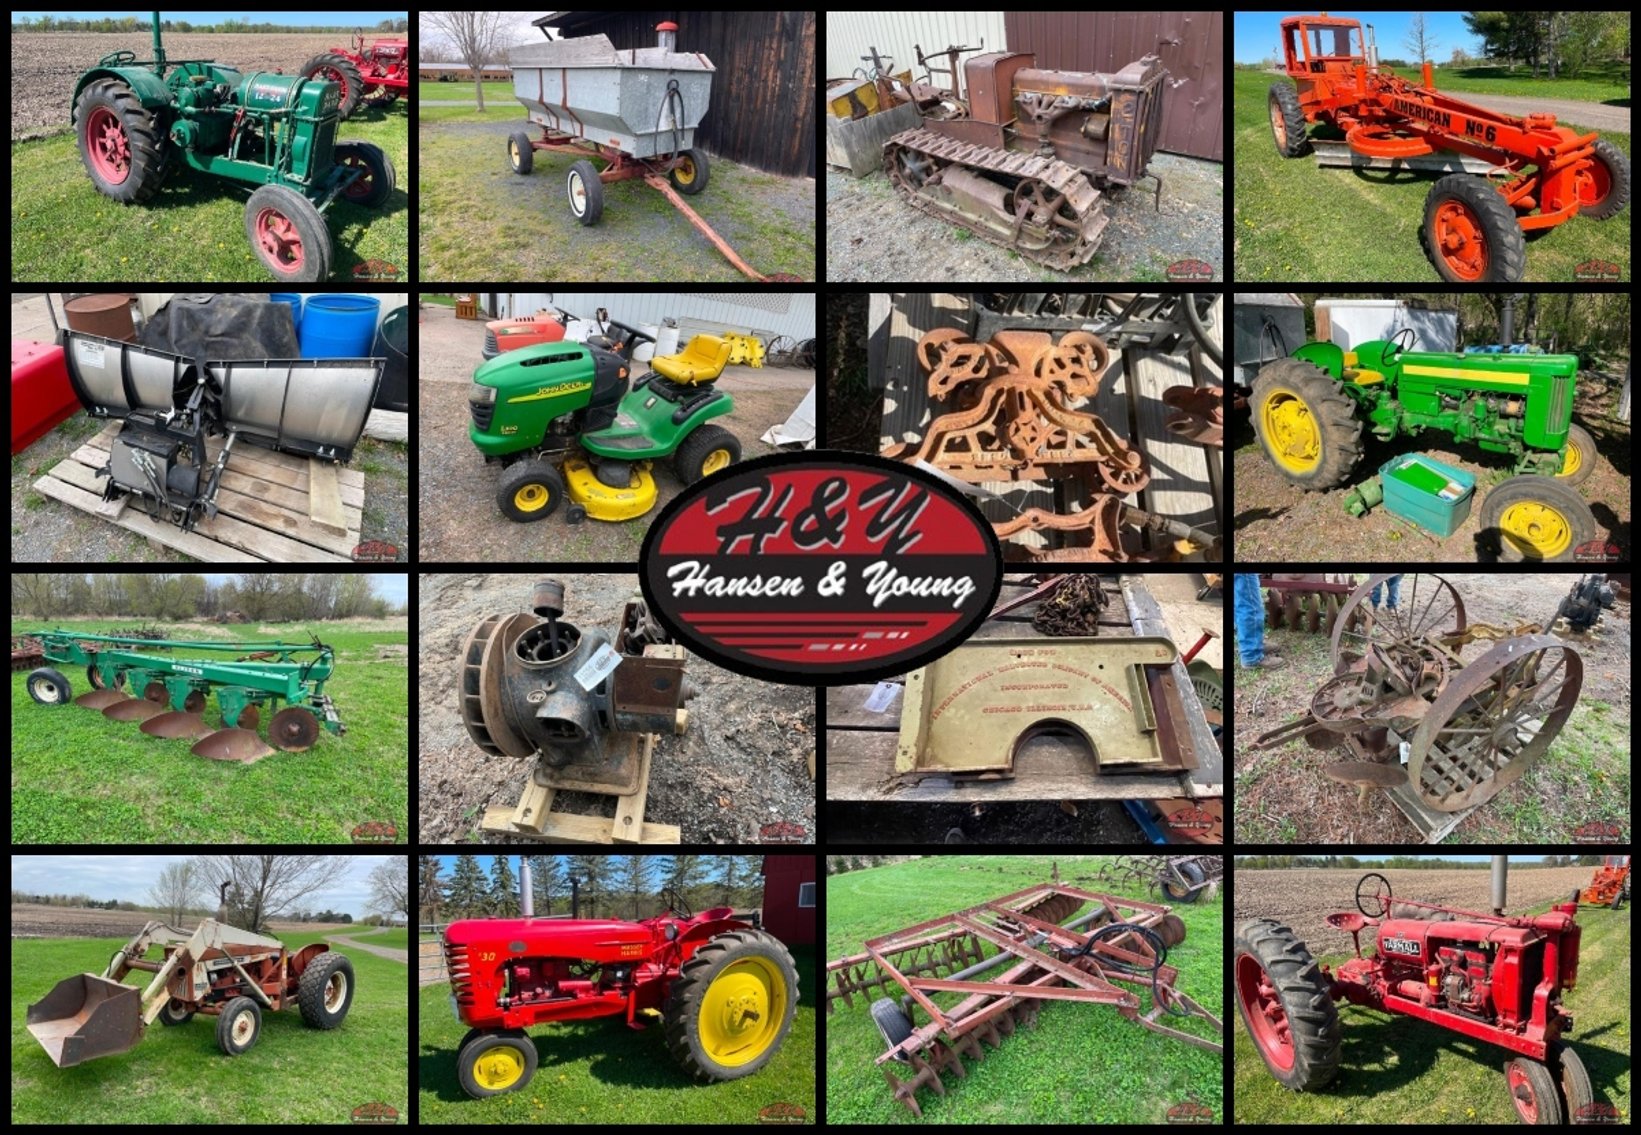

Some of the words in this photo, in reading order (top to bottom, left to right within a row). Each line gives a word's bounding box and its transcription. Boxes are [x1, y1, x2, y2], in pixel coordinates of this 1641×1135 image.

[1394, 99, 1451, 129] AMERICAN
[536, 385, 559, 396] JOHN
[1383, 938, 1420, 954] FARMALL
